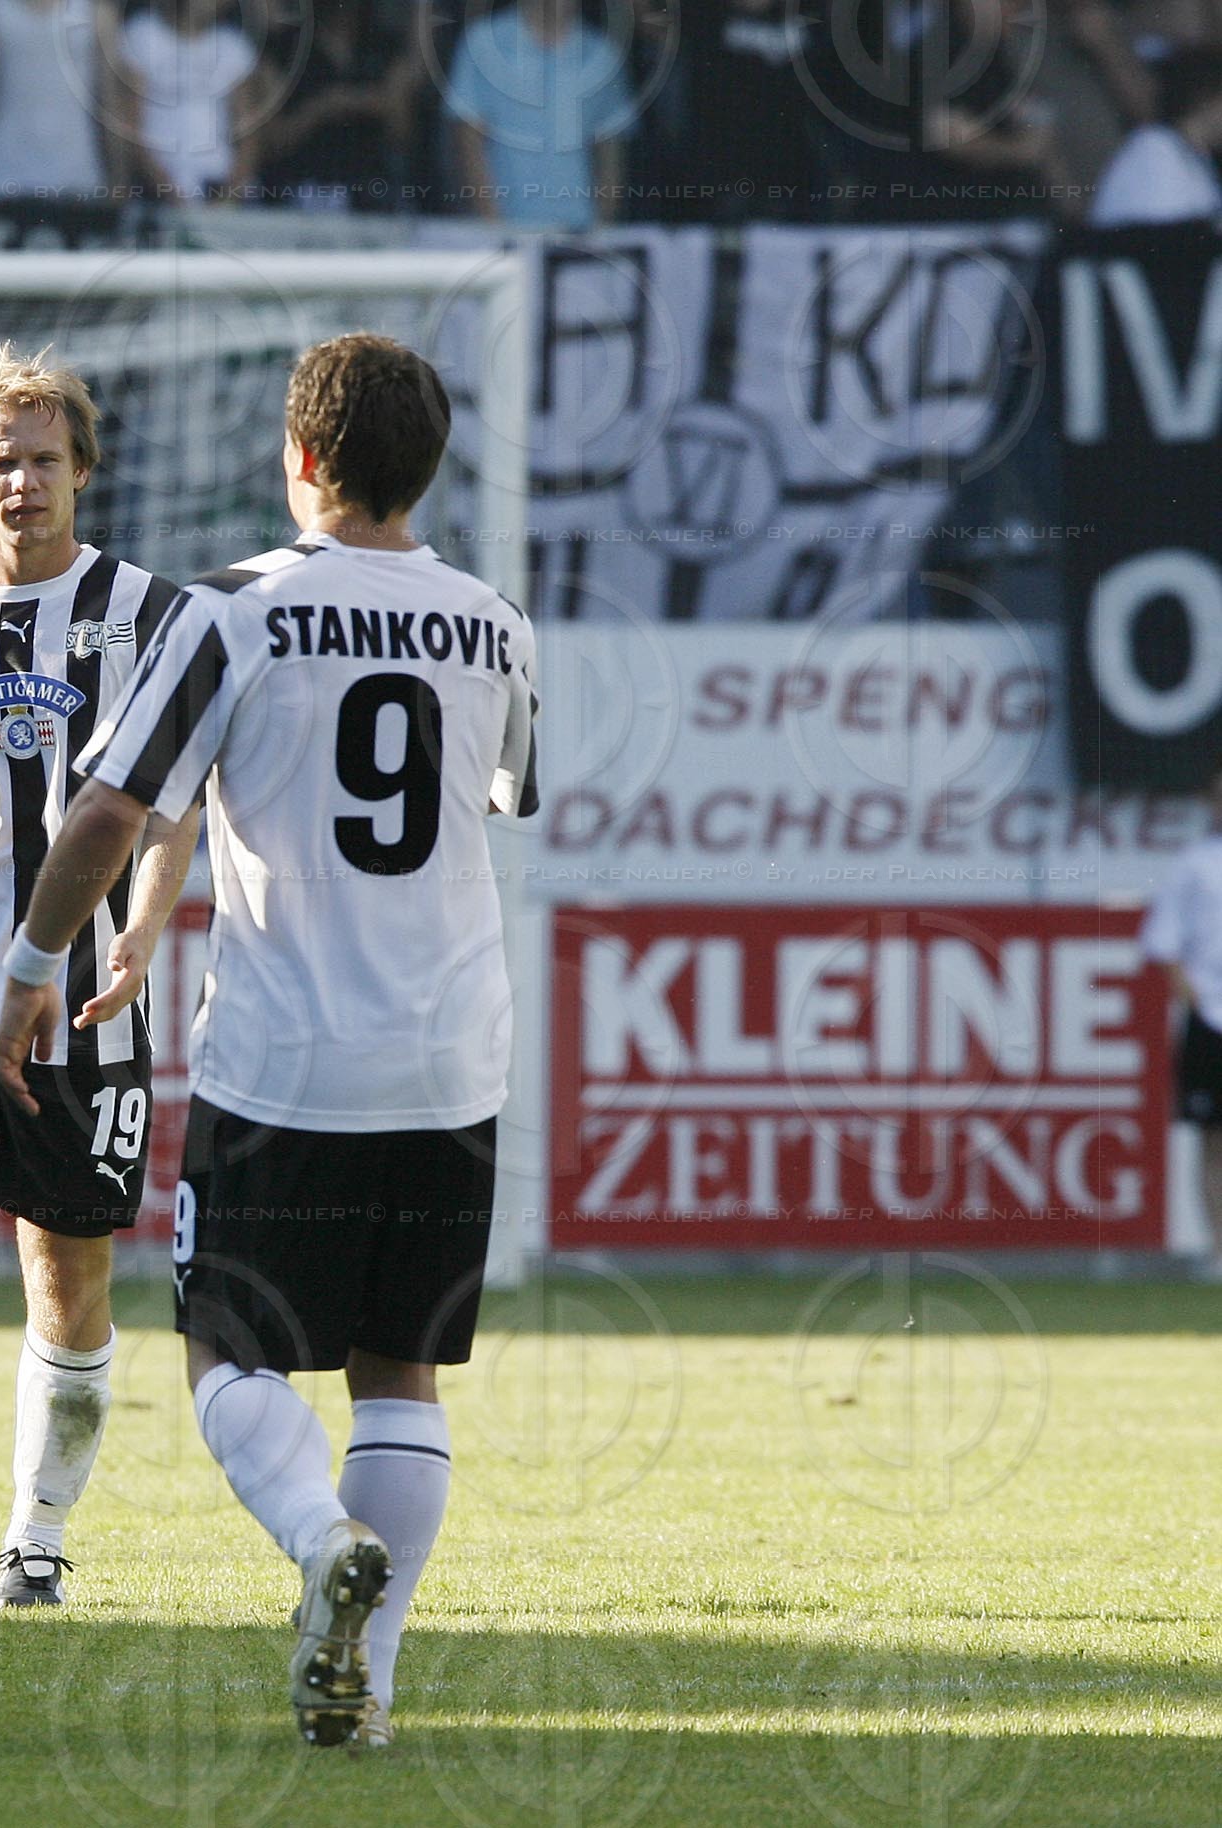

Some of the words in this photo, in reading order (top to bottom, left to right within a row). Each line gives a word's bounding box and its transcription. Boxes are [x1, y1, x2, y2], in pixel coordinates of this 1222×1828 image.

[690, 665, 1051, 733] SPENG
[334, 672, 443, 876] 9
[545, 788, 1222, 854] DACHDECKE
[581, 935, 1143, 1078] KLEINE
[90, 1086, 147, 1160] 19
[581, 1114, 1143, 1222] ZEITUNG
